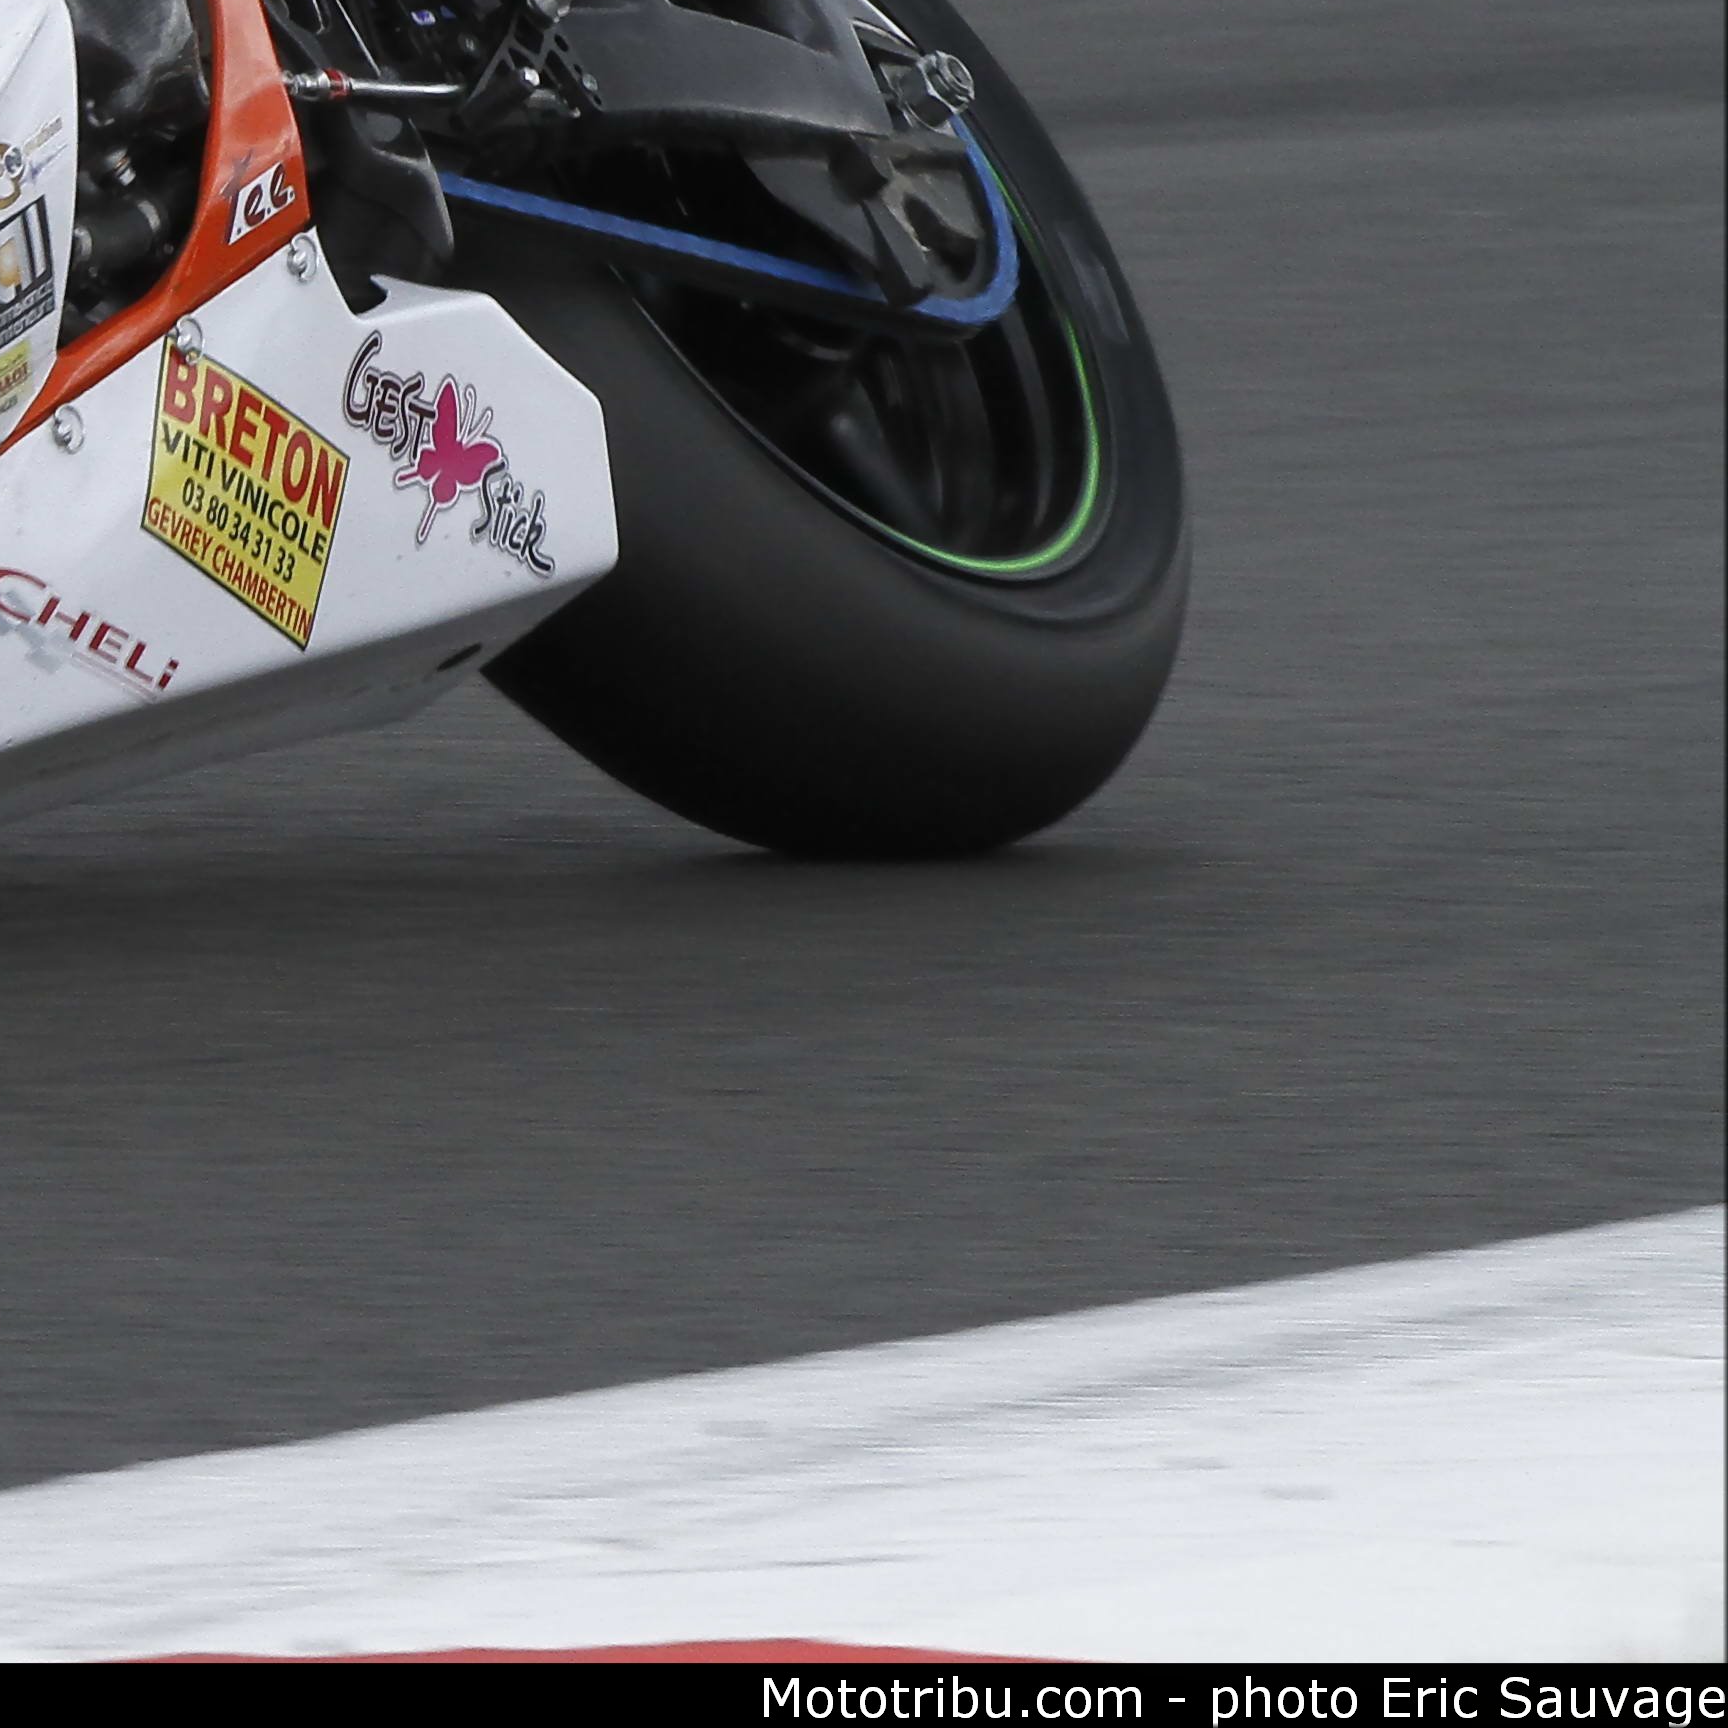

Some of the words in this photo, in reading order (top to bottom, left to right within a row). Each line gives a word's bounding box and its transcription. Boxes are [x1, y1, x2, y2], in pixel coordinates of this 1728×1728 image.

[161, 420, 215, 480] VITI
[221, 458, 328, 566] VINICOLE
[162, 344, 344, 530] BRETON
[147, 496, 214, 564] GEVREY
[211, 543, 313, 641] CHAMBERTIN
[182, 476, 206, 516] 03
[206, 495, 230, 533] 80
[228, 512, 251, 552] 34
[251, 529, 273, 568] 31
[273, 545, 297, 585] 33
[473, 460, 553, 572] Stick
